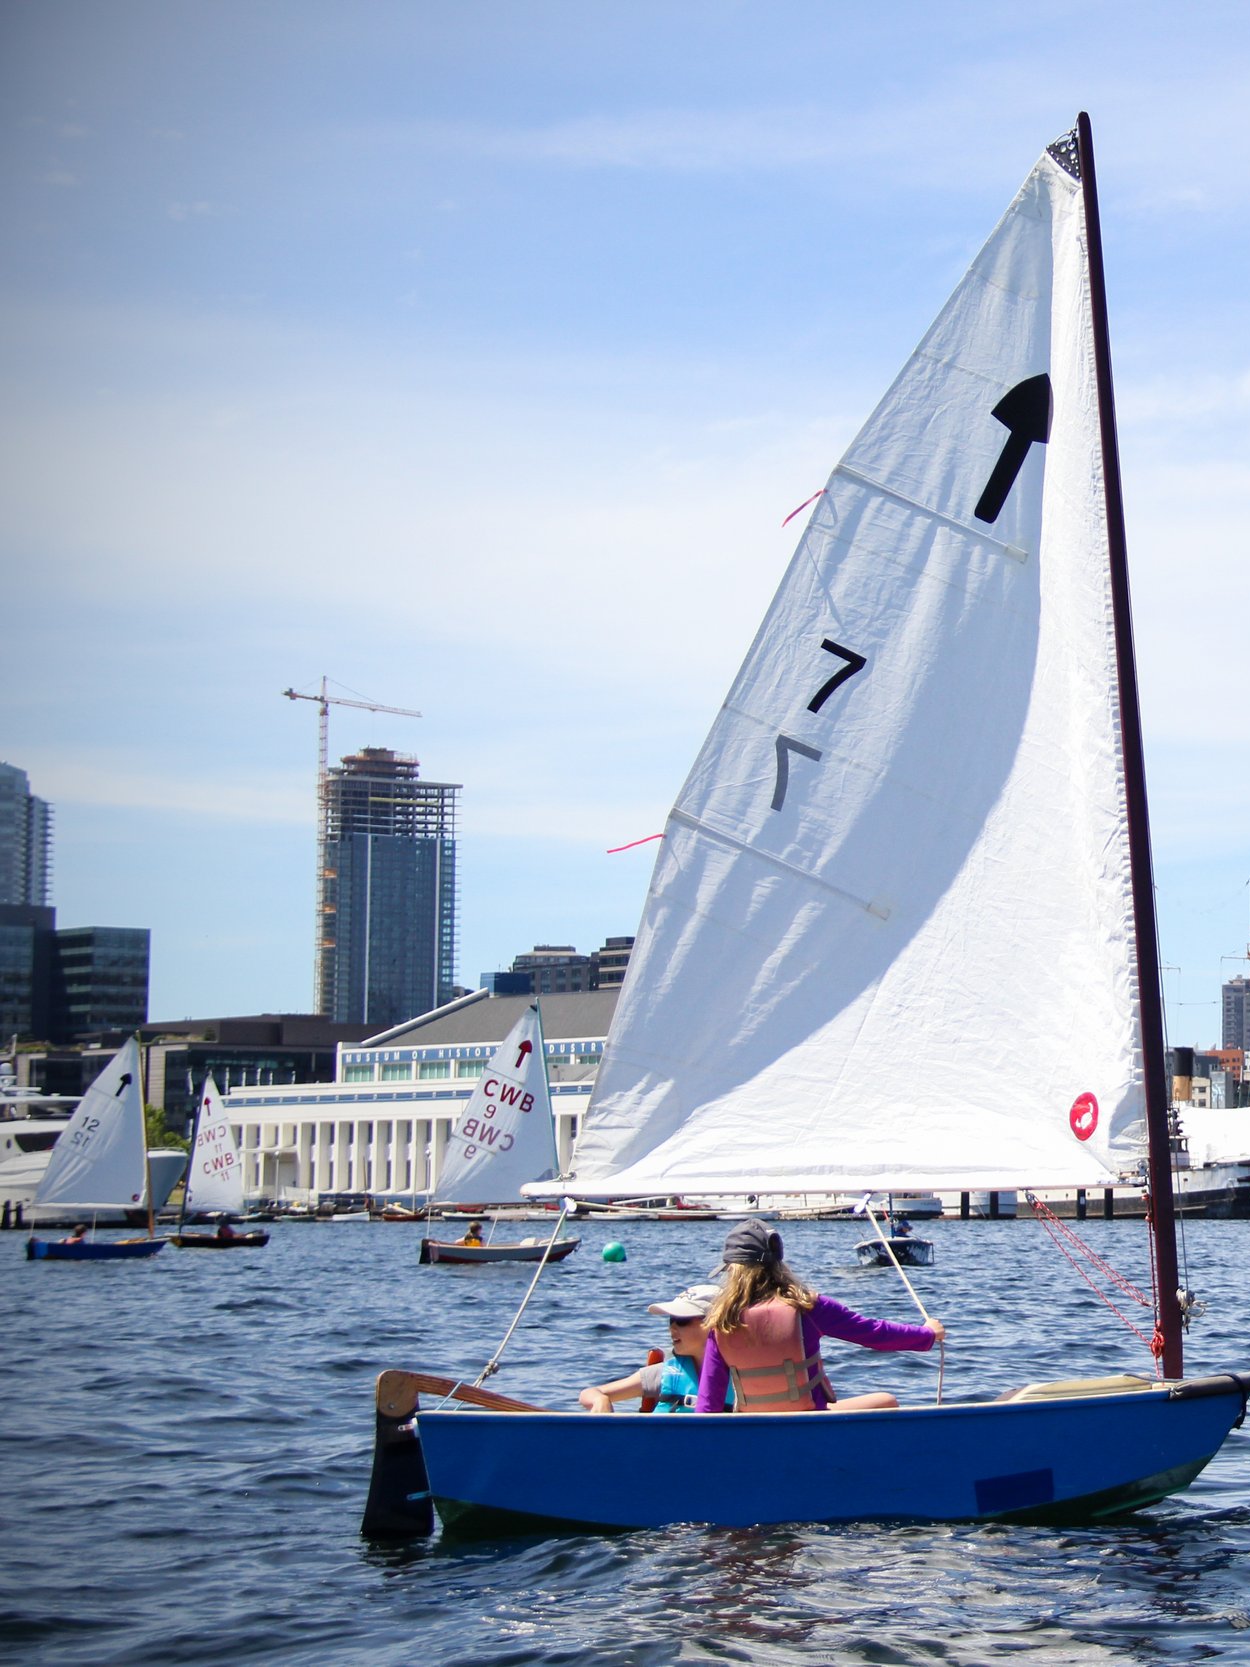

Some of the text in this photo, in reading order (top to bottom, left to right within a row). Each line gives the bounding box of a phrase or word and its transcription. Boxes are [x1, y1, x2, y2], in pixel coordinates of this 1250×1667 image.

[807, 638, 867, 714] 7
[346, 1051, 400, 1062] MUSEUM
[412, 1050, 427, 1060] OF
[549, 1041, 606, 1054] DUSTRY
[484, 1079, 535, 1113] CWB
[484, 1104, 497, 1119] 9
[82, 1116, 100, 1132] 12
[203, 1152, 234, 1175] CWB
